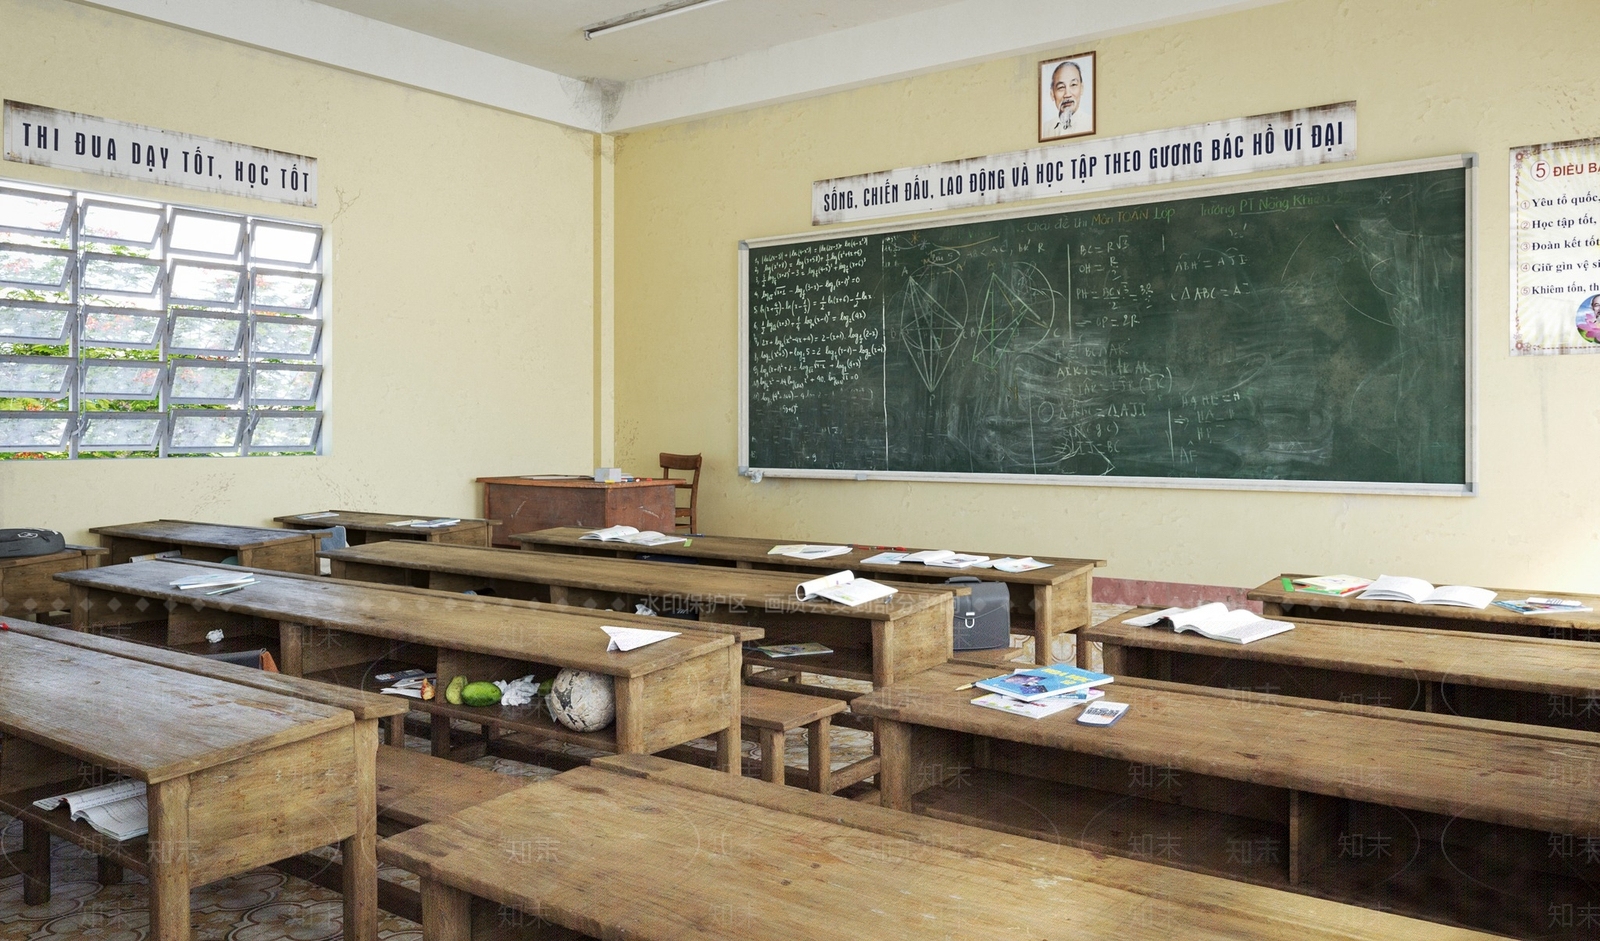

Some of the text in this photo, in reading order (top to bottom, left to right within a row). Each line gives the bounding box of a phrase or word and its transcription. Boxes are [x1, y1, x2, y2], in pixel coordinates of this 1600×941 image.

[23, 122, 310, 192] THI ĐUA DẠY TỐT, HỌC TỐT
[824, 121, 1343, 210] SỐNG, CHIẾN ĐẤU, LAO ĐỘNG VÀ HỌC TẬP THEO GƯƠNG BÁC HỒ VĨ ĐẠI
[1534, 162, 1548, 180] 5
[1553, 163, 1584, 177] ĐIỀU
[1239, 198, 1254, 212] PT
[1532, 198, 1553, 208] Yêu
[1532, 220, 1553, 230] Học
[1557, 217, 1575, 229] tập
[1578, 213, 1597, 225] tốt,
[1532, 241, 1560, 251] Đoàn
[1564, 236, 1581, 248] kết
[1577, 259, 1589, 271] vệ
[1532, 284, 1564, 295] Khiêm
